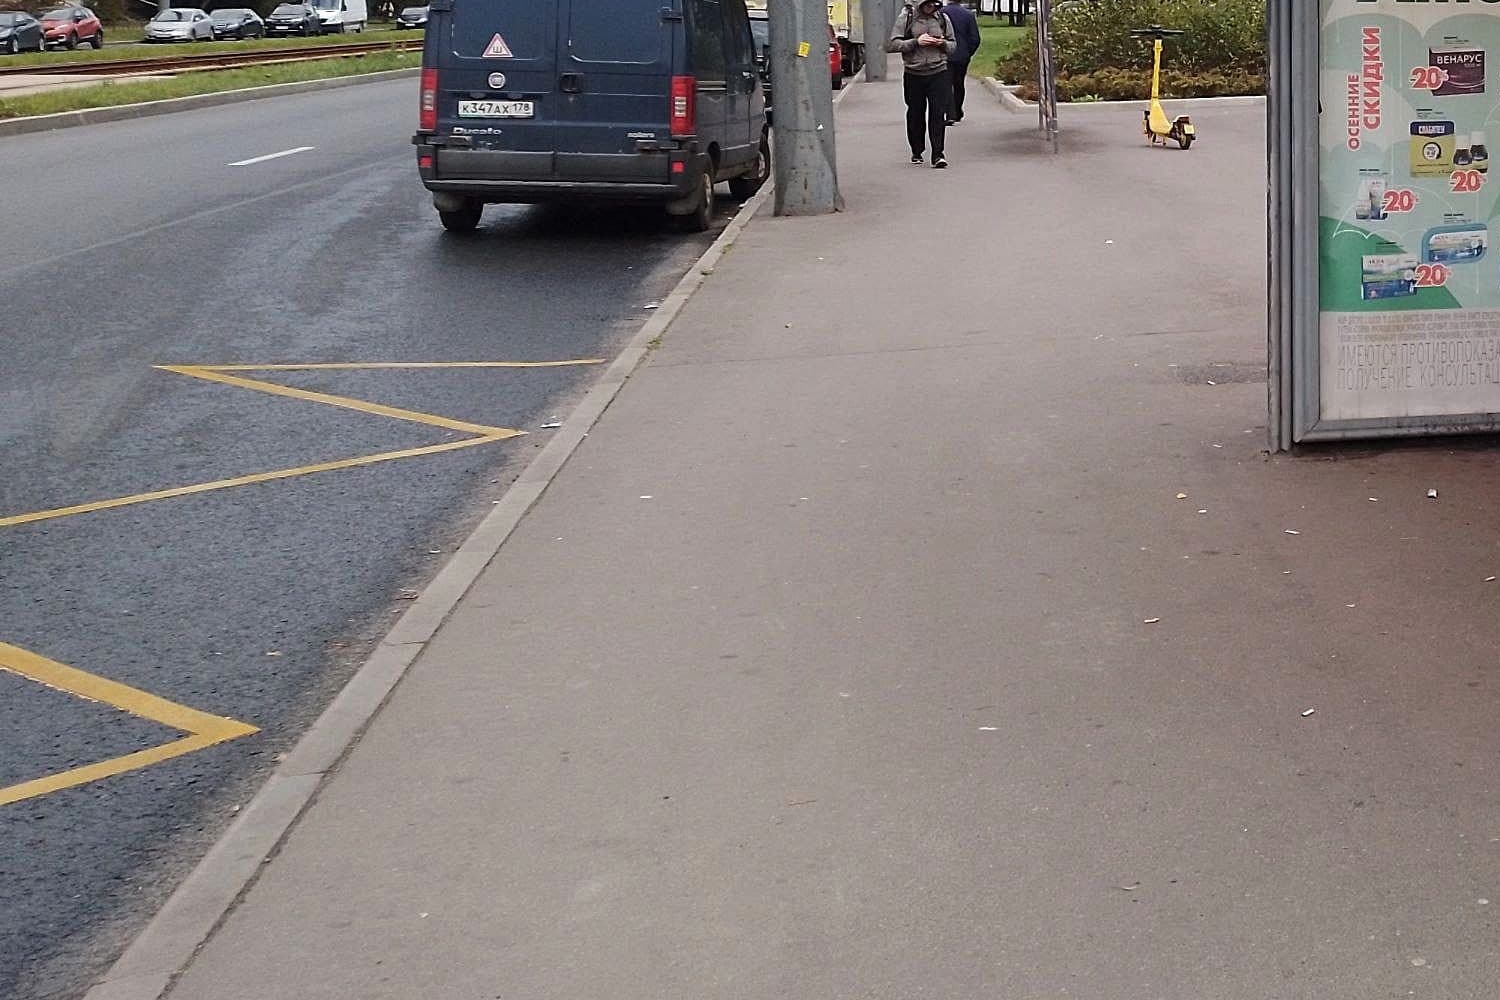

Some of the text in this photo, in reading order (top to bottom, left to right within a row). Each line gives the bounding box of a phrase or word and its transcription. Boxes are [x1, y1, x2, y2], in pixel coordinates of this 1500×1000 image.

[1436, 54, 1482, 64] ВЕНАРУС
[1363, 27, 1383, 130] СКИДКИ
[462, 102, 530, 114] К347АХ 178
[1348, 74, 1360, 150] ОСЕННИЕ
[453, 127, 503, 135] Ducato
